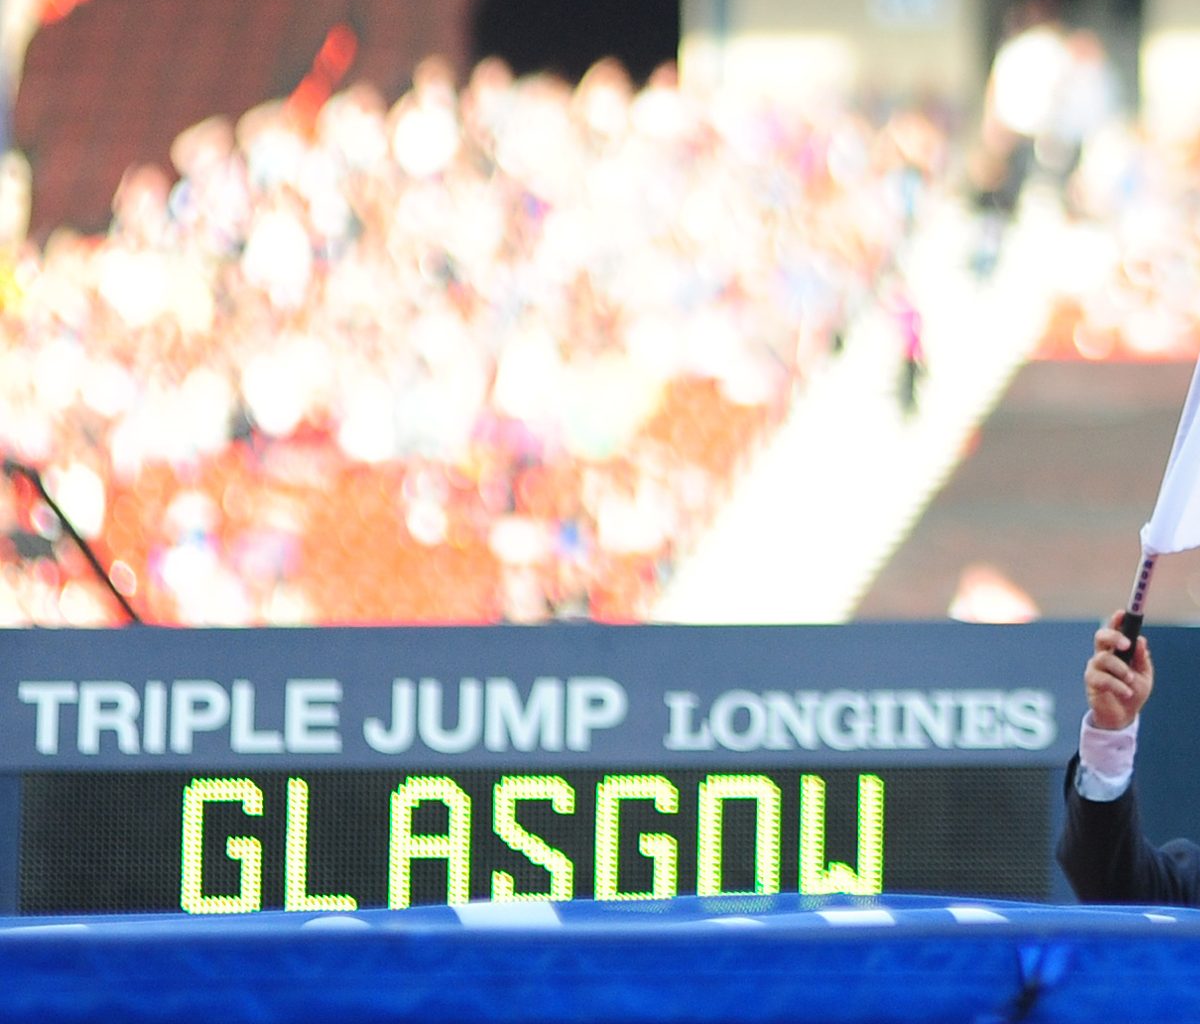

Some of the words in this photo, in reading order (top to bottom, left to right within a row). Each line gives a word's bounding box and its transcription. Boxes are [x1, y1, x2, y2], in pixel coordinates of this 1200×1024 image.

[18, 678, 343, 754] TRIPLE
[363, 676, 628, 753] JUMP
[663, 687, 1056, 752] LONGINES
[181, 774, 884, 913] GLASGOW
